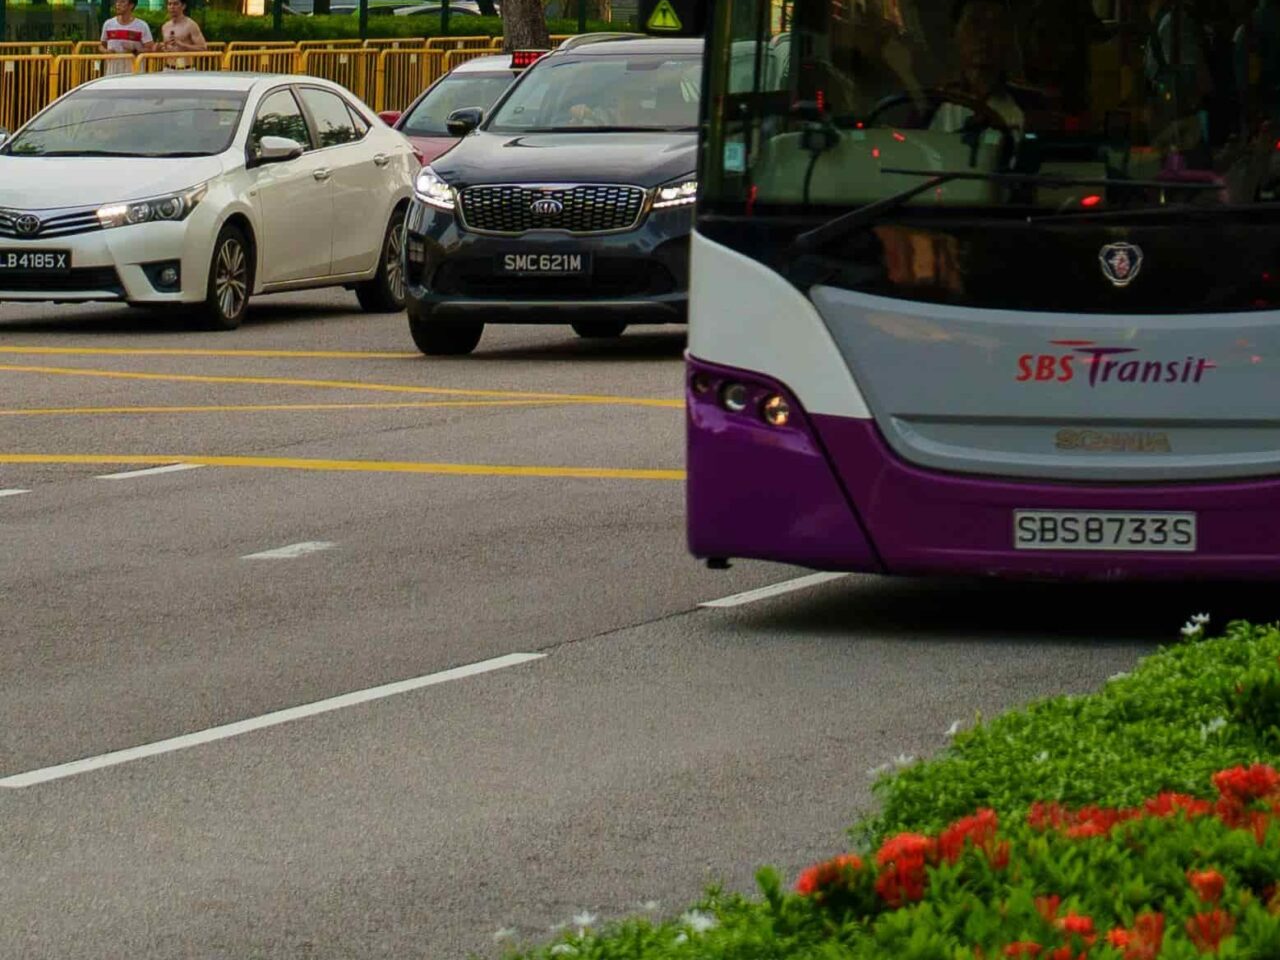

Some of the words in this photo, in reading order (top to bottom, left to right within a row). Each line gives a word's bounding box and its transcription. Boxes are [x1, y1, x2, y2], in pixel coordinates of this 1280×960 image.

[1016, 354, 1075, 382] SBS
[1072, 347, 1217, 388] Transit
[1018, 516, 1192, 545] SBS8733S
